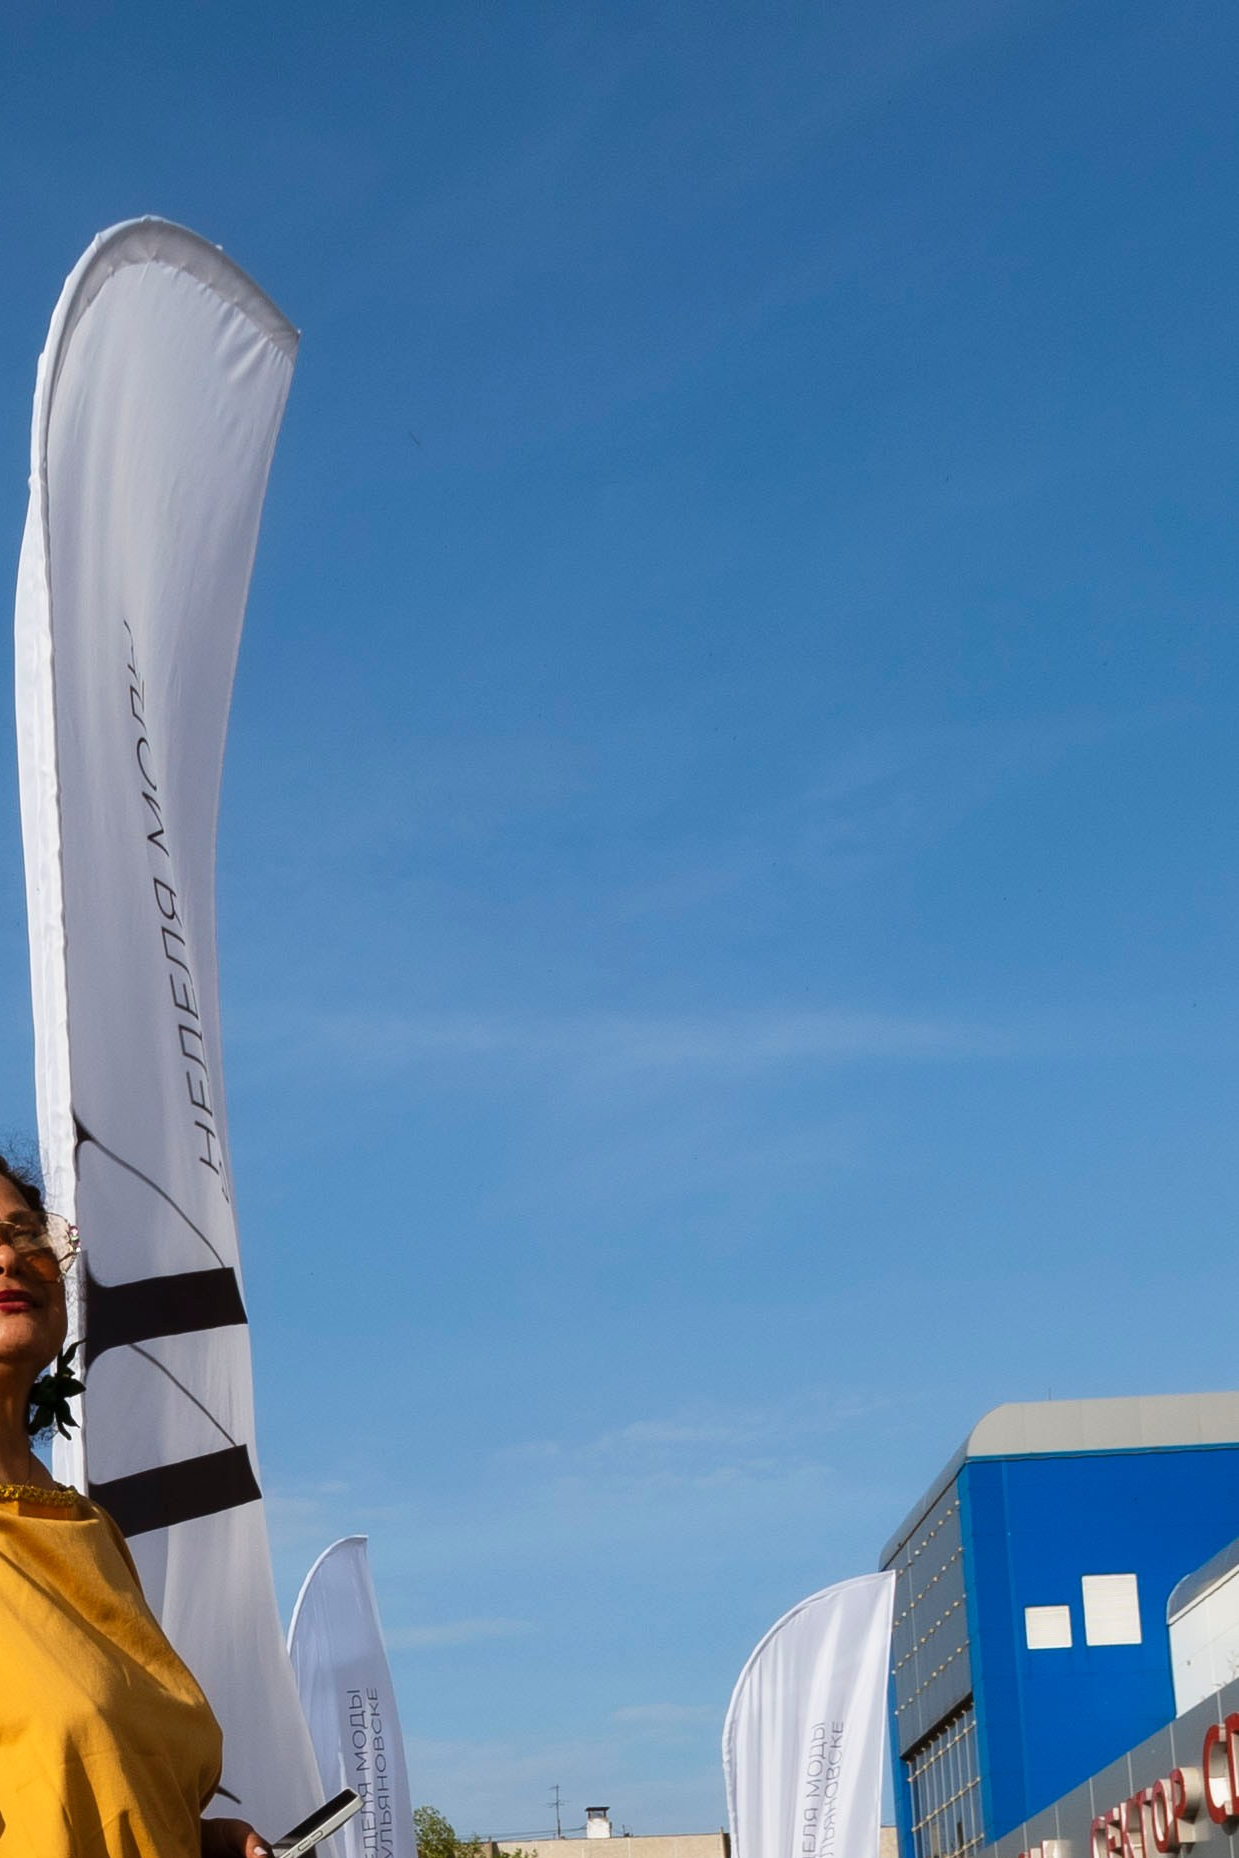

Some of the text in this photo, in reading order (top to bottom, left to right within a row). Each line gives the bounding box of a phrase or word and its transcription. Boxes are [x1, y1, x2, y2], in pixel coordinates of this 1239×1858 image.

[154, 877, 220, 1174] НЕДЕЛЯ
[346, 1689, 371, 1772] МОДЫ
[806, 1722, 828, 1799] МОДЫ
